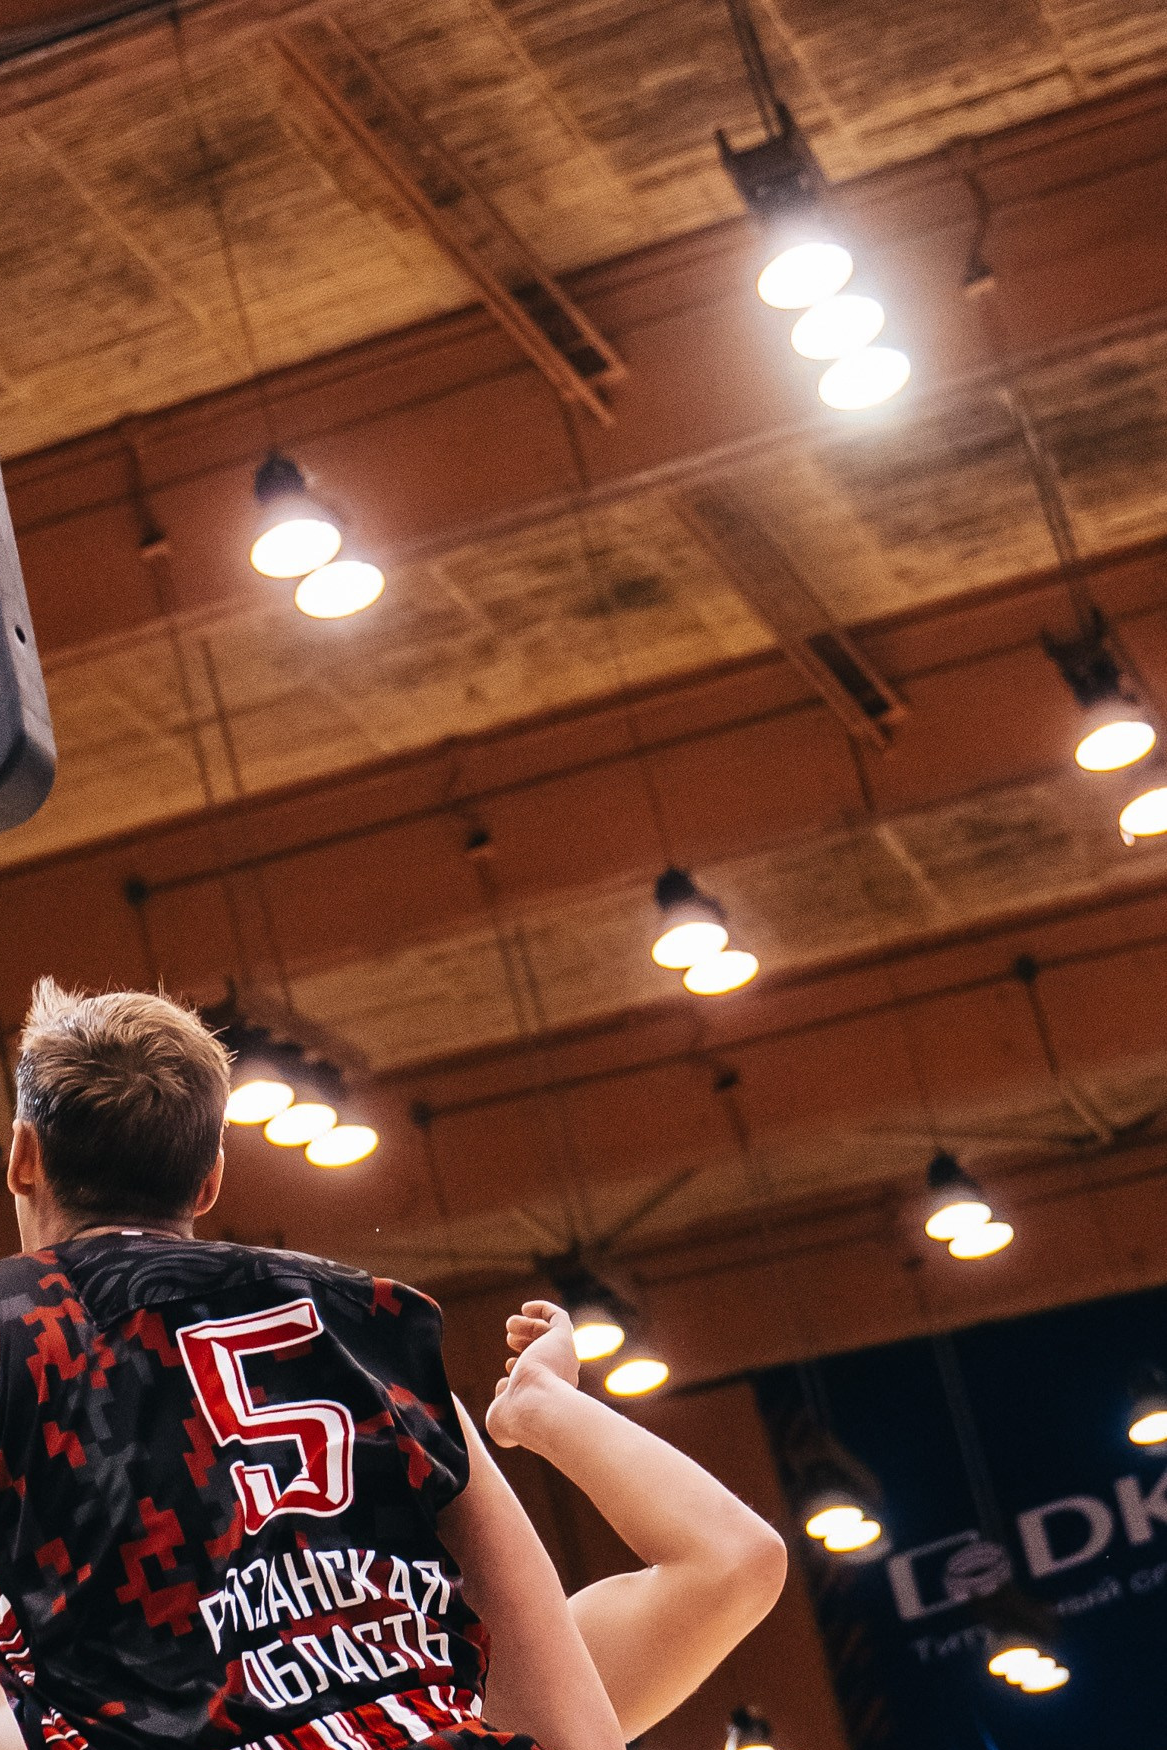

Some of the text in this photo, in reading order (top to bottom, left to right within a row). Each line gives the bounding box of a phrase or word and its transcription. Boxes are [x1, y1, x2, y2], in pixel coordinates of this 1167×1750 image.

[176, 1298, 356, 1536] 5
[198, 1548, 453, 1655] РЯЗАНСКАЯ
[241, 1611, 453, 1710] ОБЛАСТЬ
